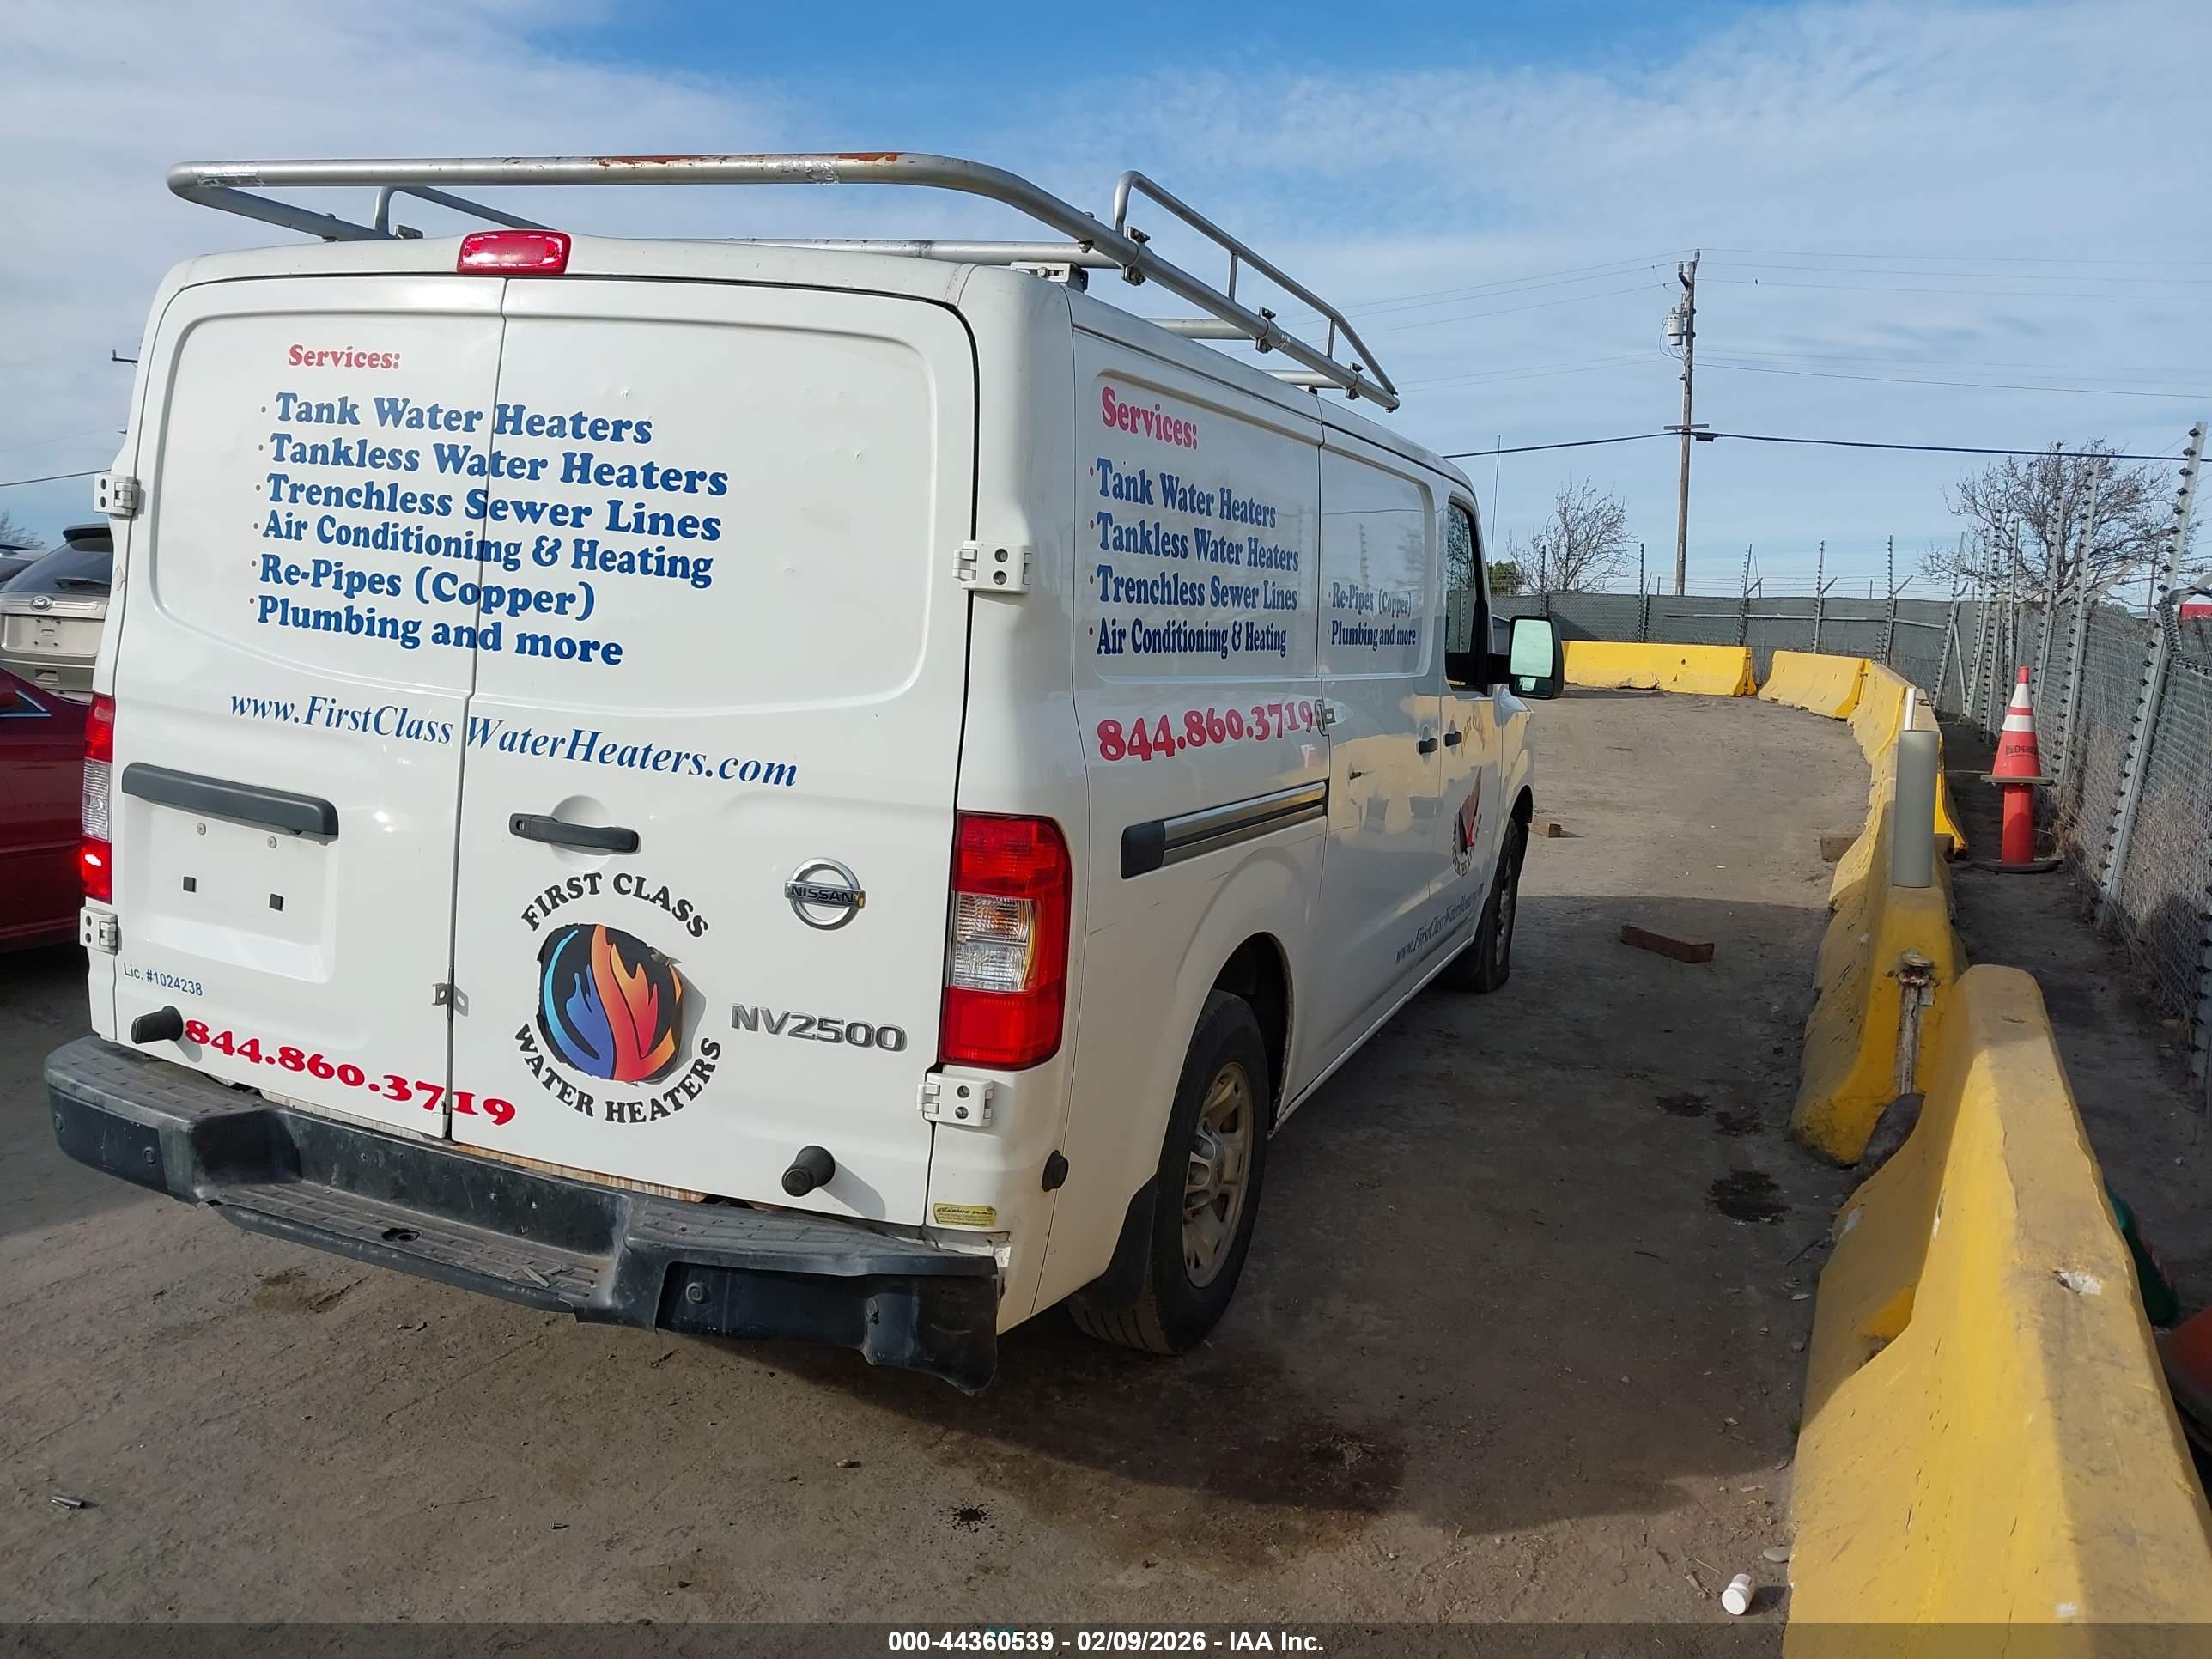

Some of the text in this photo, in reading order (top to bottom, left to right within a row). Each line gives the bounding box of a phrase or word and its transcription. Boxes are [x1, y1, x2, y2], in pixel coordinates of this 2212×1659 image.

[289, 344, 401, 369] Services:
[276, 392, 653, 445] Tank Water Heaters
[1101, 386, 1198, 449] Services:
[272, 433, 729, 496] Tankless Water Heaters
[1096, 457, 1276, 529] Tank Water Heaters
[267, 473, 721, 542] Trenchless Sewer Lines
[264, 509, 308, 541] Air
[532, 535, 562, 568] &
[570, 538, 714, 589] Heating
[1097, 511, 1299, 572] Tankless Water Heaters
[260, 553, 595, 622] Re-Pipes (Copper)
[1097, 563, 1297, 611] Trenchless Sewer Lines
[1332, 582, 1411, 617] Re-Pipes (Copper)
[257, 594, 623, 666] Plumbing and more
[1096, 617, 1127, 655] Air
[1231, 618, 1243, 651] &
[1244, 621, 1287, 659] Heating
[1331, 620, 1416, 651] Plumbing and more
[1097, 700, 1313, 762] 844.860.3719
[521, 872, 708, 938] FIRST CLASS
[791, 885, 854, 903] NISSAN
[123, 962, 203, 996] Lic. #1024238
[731, 1004, 908, 1053] NV2500
[185, 1018, 516, 1127] 844.860.3719
[514, 1023, 721, 1123] WATER HEATERS
